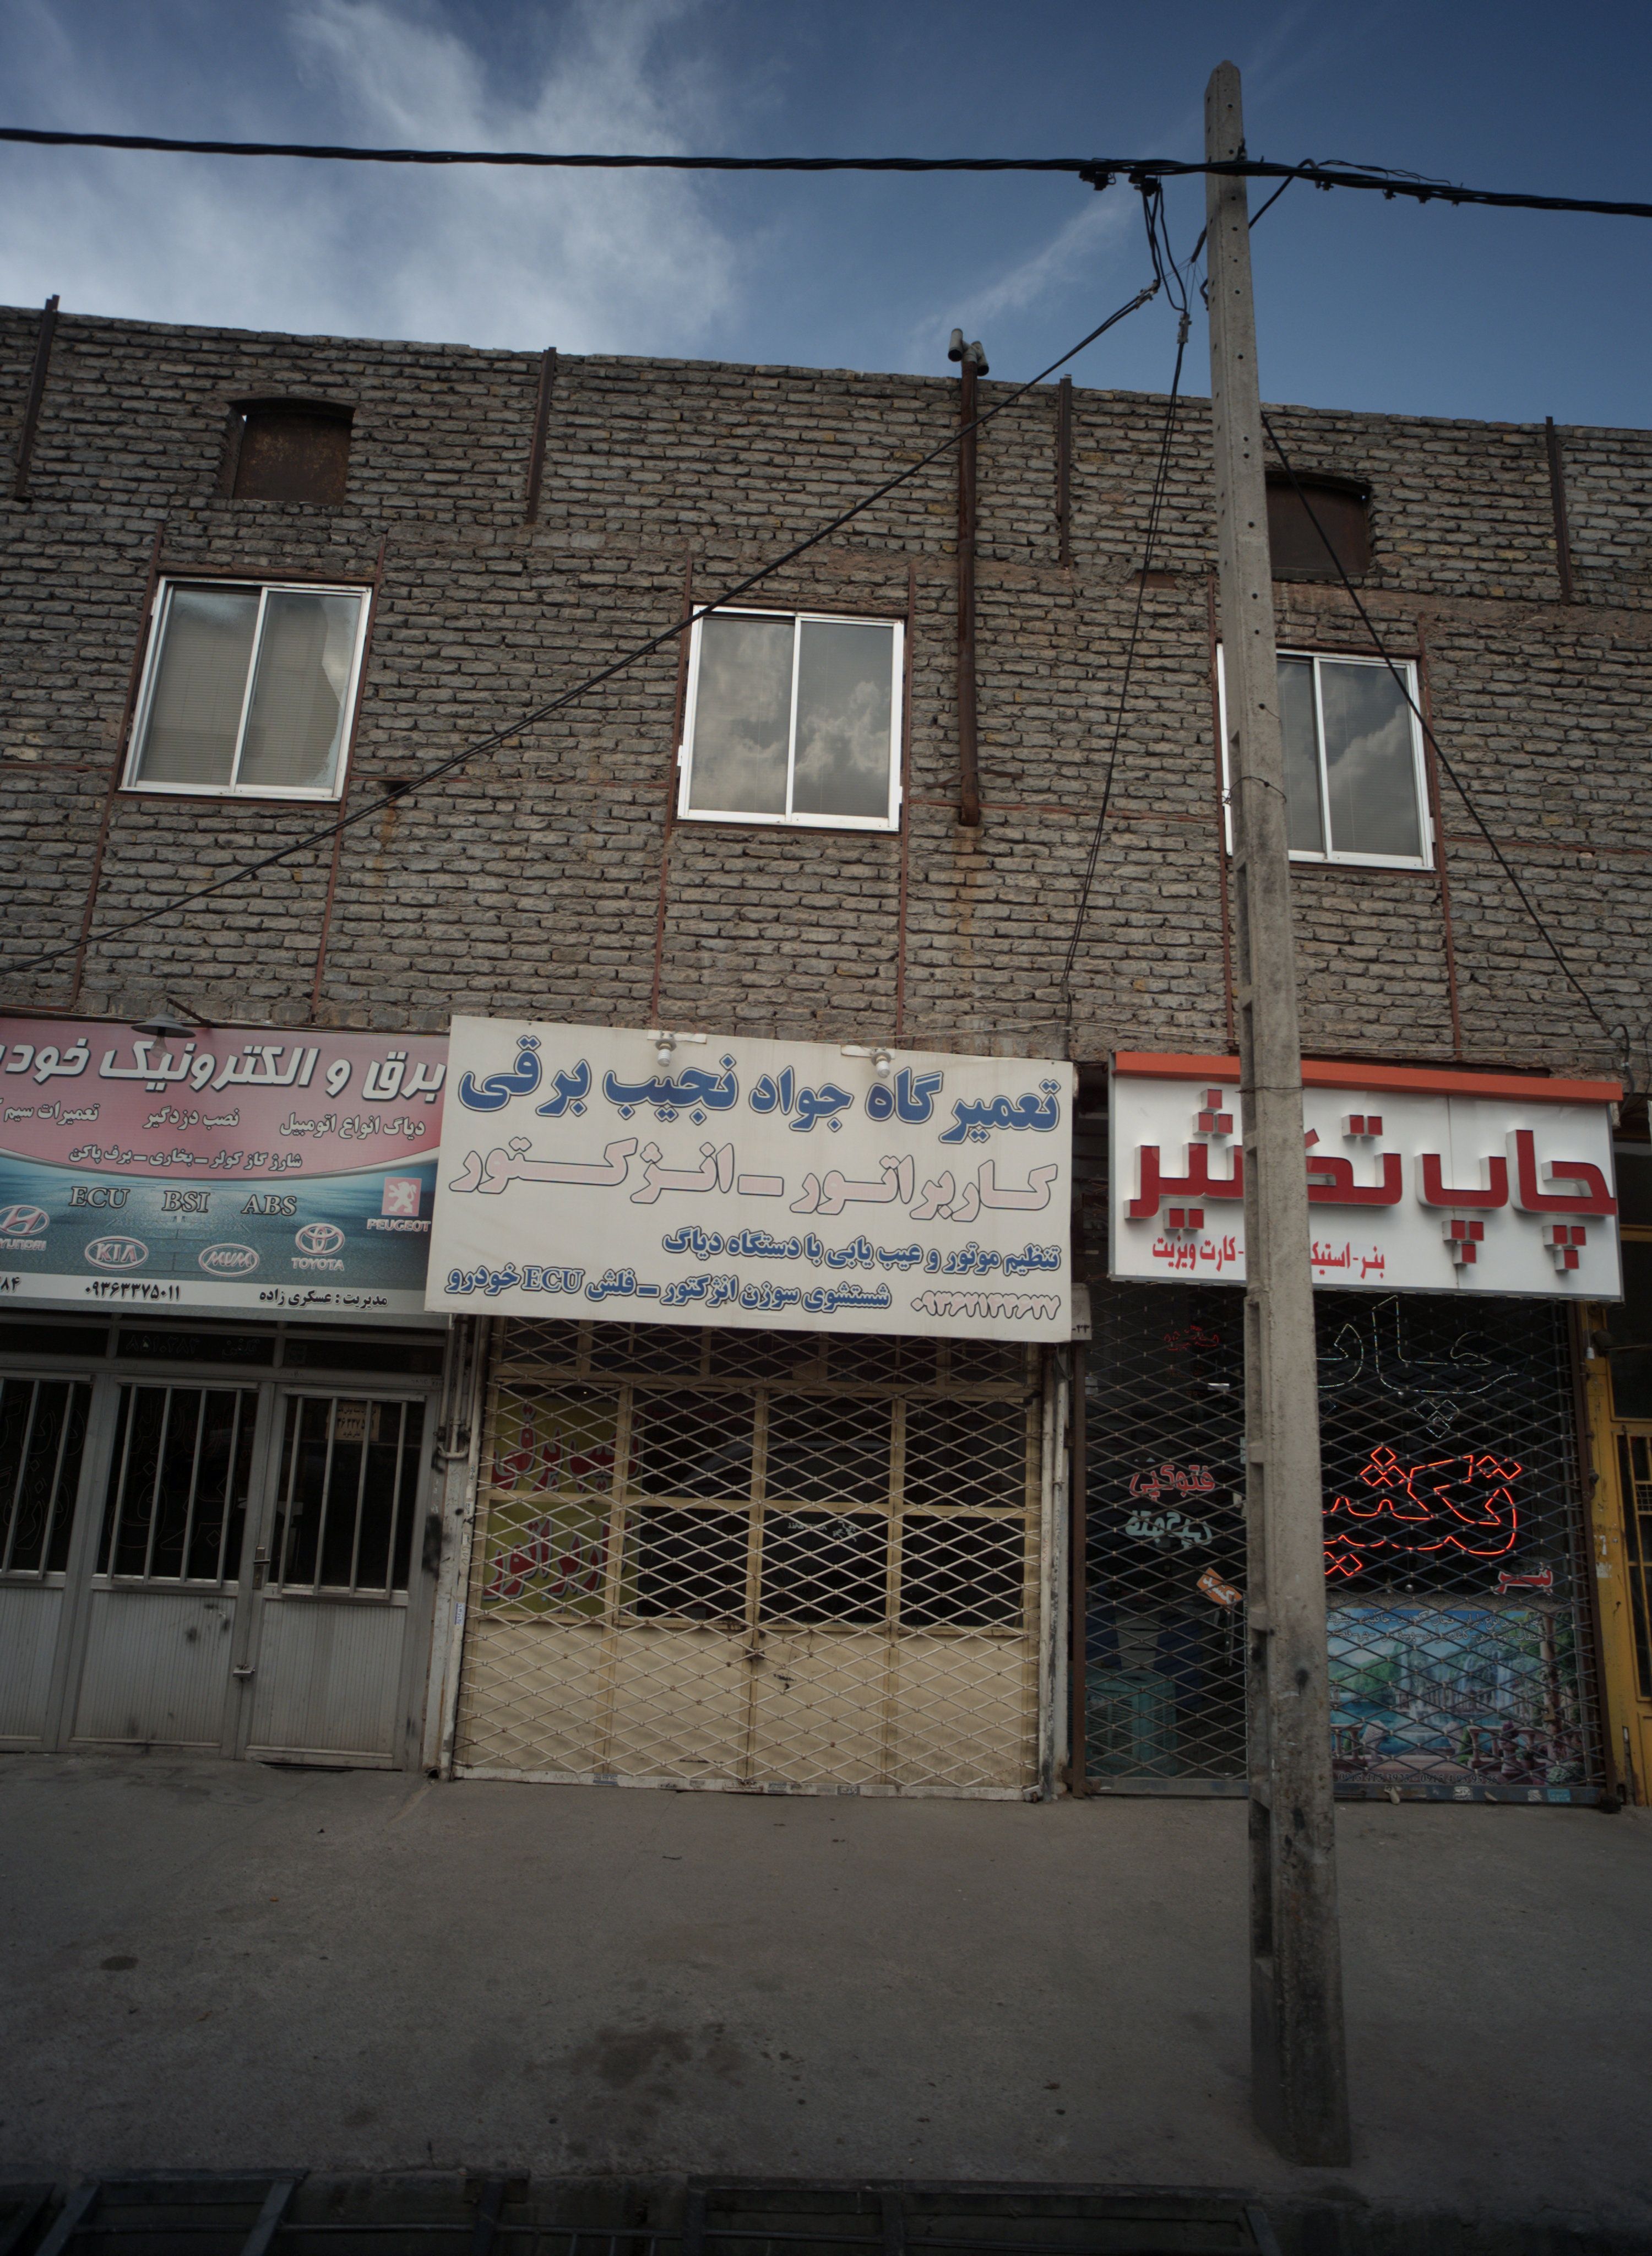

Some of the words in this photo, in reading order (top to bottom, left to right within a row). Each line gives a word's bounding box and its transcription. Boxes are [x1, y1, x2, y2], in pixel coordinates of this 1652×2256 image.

[0, 1038, 90, 1084] خود
[100, 1040, 320, 1092] الکترونیک
[325, 1058, 352, 1097] و
[362, 1051, 447, 1103] برق
[459, 1035, 591, 1117] برقی
[602, 1054, 738, 1125] نجیب
[749, 1065, 854, 1132] جواد
[865, 1066, 943, 1123] گاه
[4, 1105, 34, 1122] سیم
[37, 1102, 100, 1125] تعمیرات
[143, 1106, 199, 1130] دزدگیر
[203, 1108, 240, 1130] نصب
[280, 1112, 337, 1138] اتومبیل
[939, 1080, 1061, 1145] تعمیر
[339, 1115, 381, 1140] انواع
[383, 1116, 426, 1141] دیاگ
[69, 1145, 102, 1164] پاکن
[104, 1145, 133, 1164] برف
[149, 1148, 193, 1167] بخاری
[210, 1150, 243, 1169] کولر
[244, 1152, 268, 1170] گاز
[268, 1153, 302, 1172] شارژ
[449, 1137, 735, 1204] انژکتور
[69, 1186, 130, 1208] ECU
[161, 1190, 211, 1213] BSI
[789, 1154, 1058, 1222] کاربراتور
[1415, 1127, 1617, 1272] چاپ
[241, 1194, 297, 1216] ABS
[366, 1218, 432, 1233] PEUGEOT
[0, 1238, 47, 1251] YUNDAI
[96, 1243, 138, 1263] KIA
[662, 1226, 725, 1260] دیاگ
[725, 1229, 803, 1260] دستگاه
[804, 1232, 824, 1267] با
[825, 1235, 874, 1270] یابی
[1152, 1234, 1197, 1271] ویزیت
[1199, 1234, 1236, 1272] کارت
[291, 1257, 345, 1271] TOYOTA
[876, 1244, 924, 1271] عیب
[924, 1249, 941, 1274] و
[942, 1241, 1002, 1275] موتور
[1003, 1243, 1062, 1277] تنظیم
[85, 1281, 180, 1300] ۰۹۳۶۳۳۷۵۰۱۱
[445, 1262, 520, 1297] خودرو
[521, 1265, 584, 1293] ECU
[585, 1268, 637, 1302] فلش
[660, 1273, 739, 1308] انژکتور
[260, 1288, 285, 1306] زاده
[288, 1289, 332, 1308] عسکری
[343, 1293, 388, 1310] مدیریت
[738, 1281, 801, 1312] سوزن
[801, 1281, 893, 1314] شستشوی
